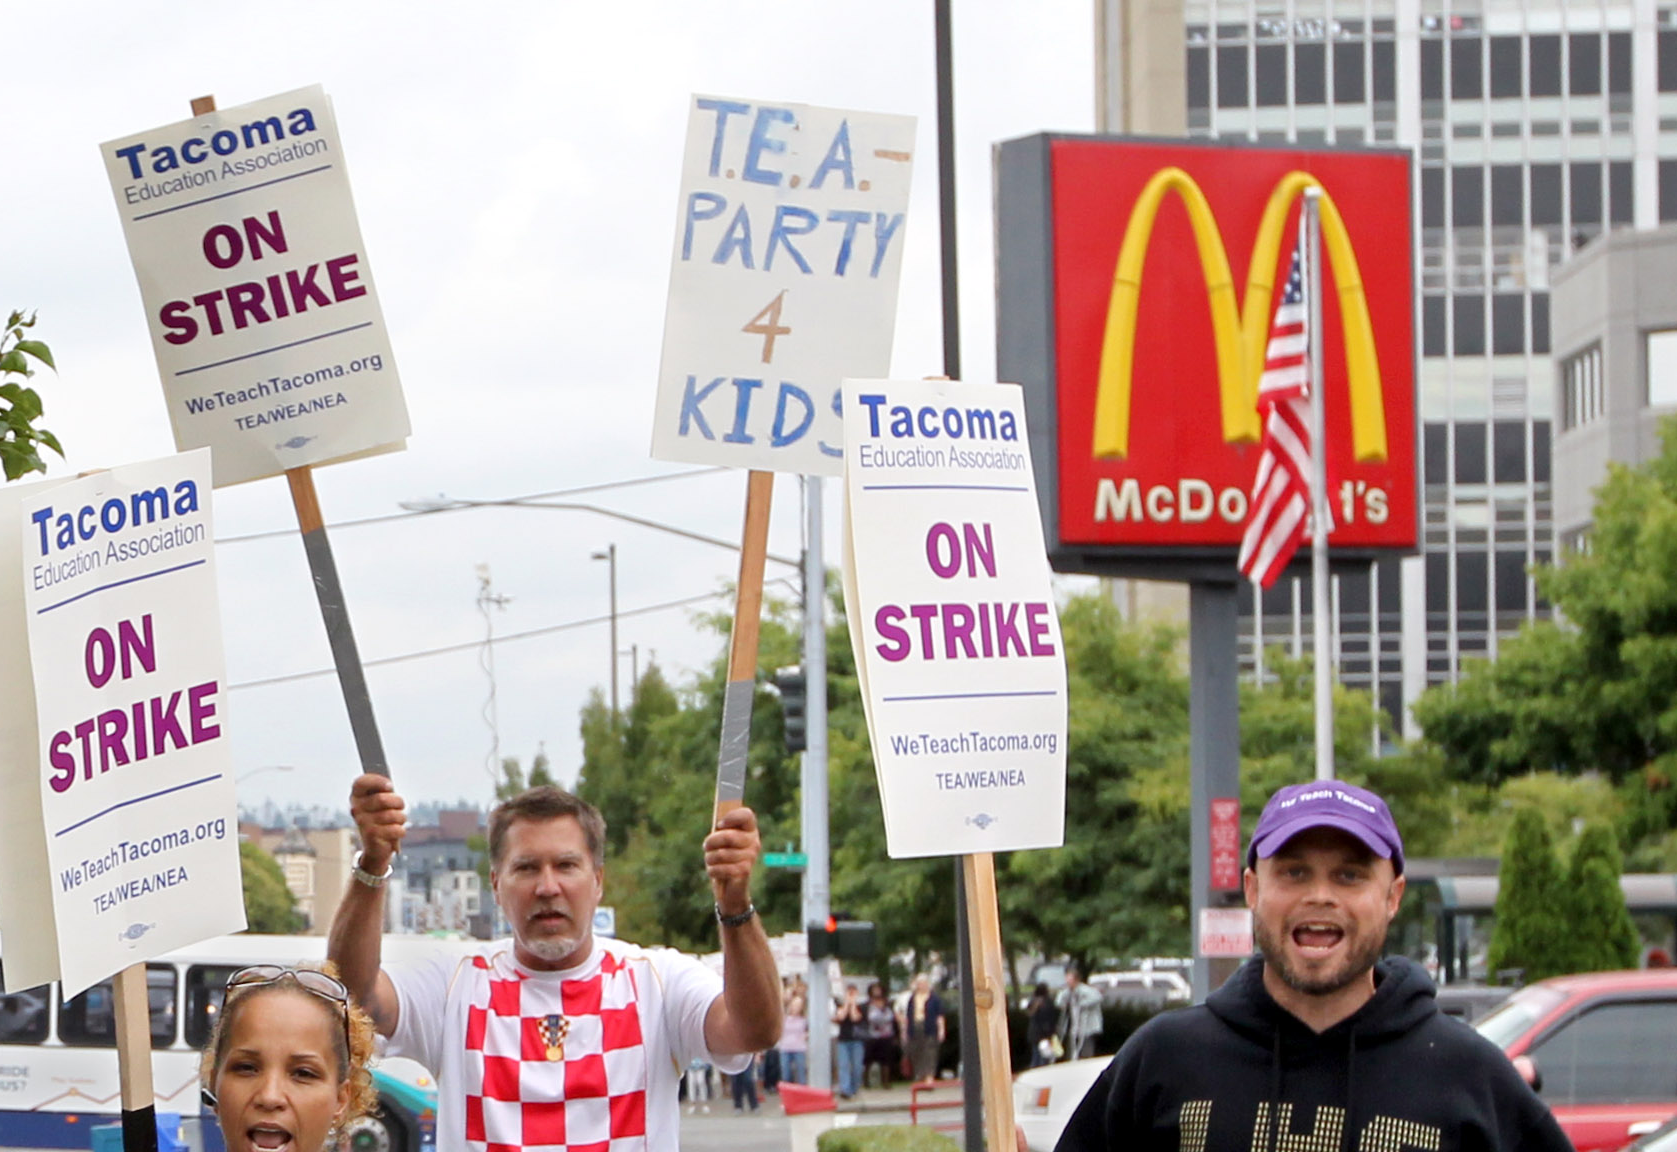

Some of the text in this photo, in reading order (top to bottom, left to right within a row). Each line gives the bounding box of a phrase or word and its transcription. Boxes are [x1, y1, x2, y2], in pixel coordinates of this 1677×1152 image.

[115, 107, 317, 180] Tacoma
[124, 136, 329, 205] Education Association
[202, 210, 289, 269] ON
[680, 192, 906, 279] PARTY
[158, 253, 367, 345] STRIKE
[741, 288, 792, 364] 4
[185, 353, 384, 416] WeTeachTacoma.org
[235, 392, 348, 432] TEA/WEA/NEA
[858, 394, 1019, 442] Tacoma
[859, 444, 1027, 471] Education Association
[32, 478, 199, 557] Tacoma
[1094, 477, 1390, 525] McDo's
[33, 521, 206, 592] Education Association
[925, 522, 998, 579] ON
[84, 613, 158, 690] ON
[874, 602, 1056, 663] STRIKE
[48, 680, 222, 794] STRIKE
[890, 731, 1058, 757] WeTeachTacoma.org
[935, 769, 1026, 791] TEA/WEA/NEA
[60, 815, 227, 893] WeTeachTacoma.org
[93, 867, 189, 916] TEA/WEA/NEA
